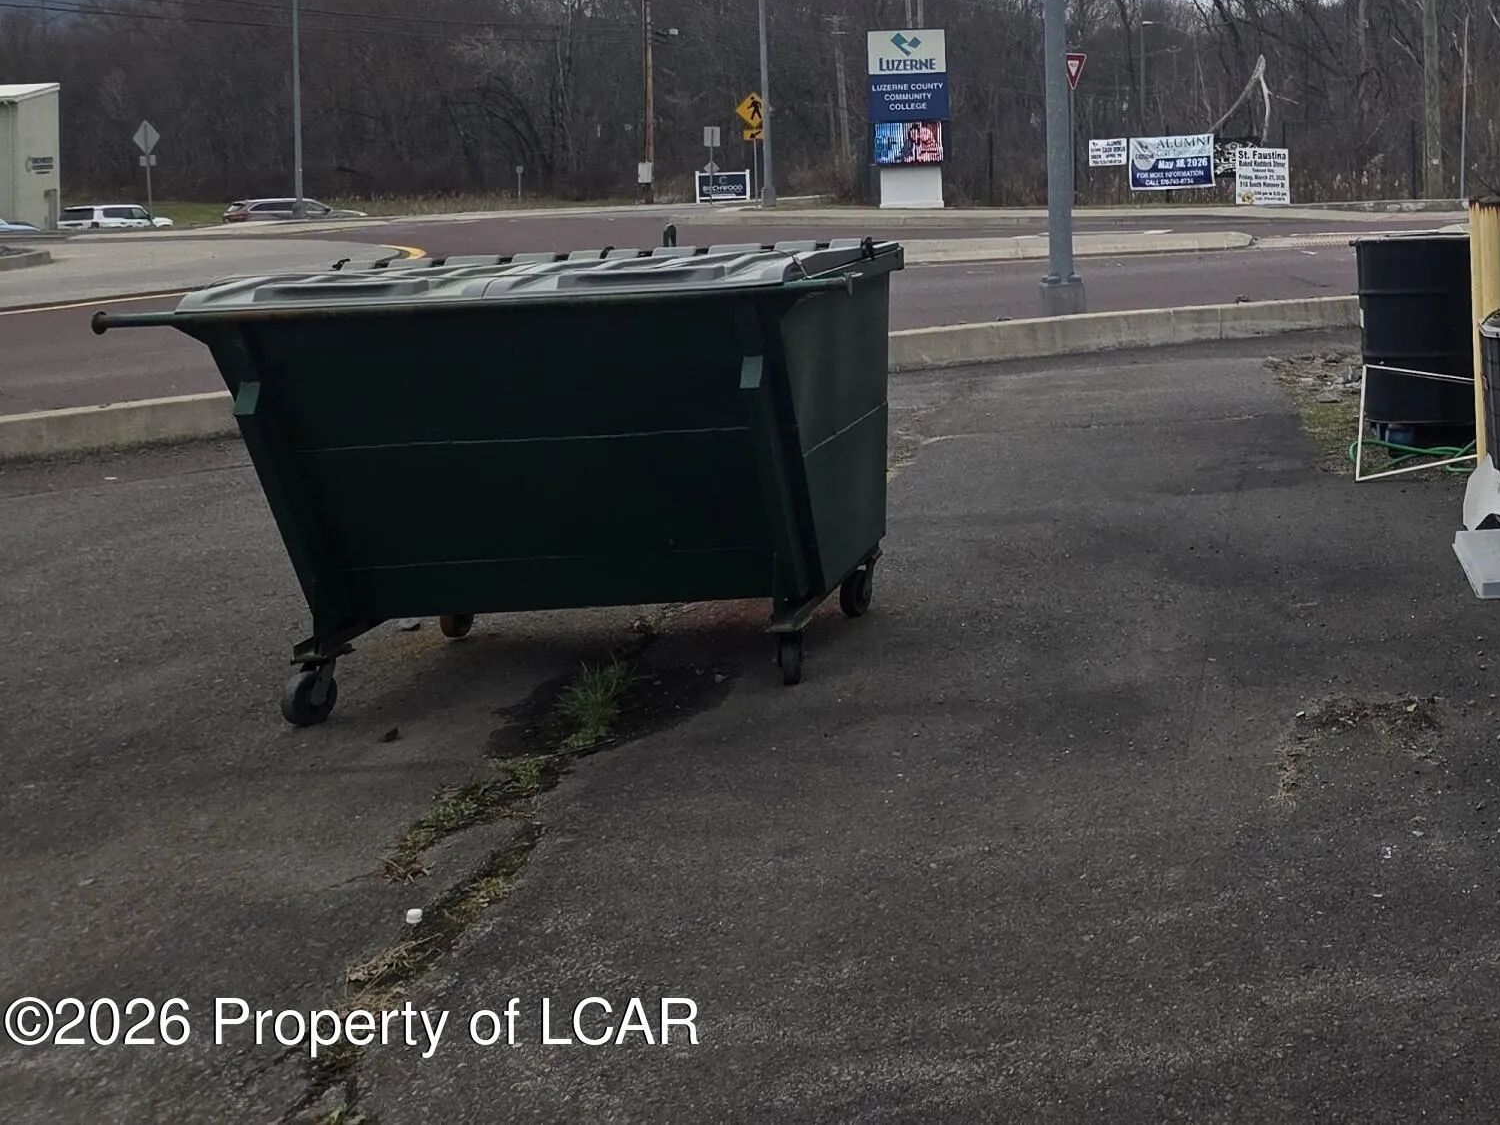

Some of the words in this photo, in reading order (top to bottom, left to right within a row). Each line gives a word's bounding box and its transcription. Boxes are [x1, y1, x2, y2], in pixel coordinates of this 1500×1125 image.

[879, 57, 937, 72] LUZERNE
[872, 84, 909, 92] LUZERNE
[910, 82, 944, 90] COUNTY
[884, 92, 932, 101] COMMUNITY
[889, 102, 928, 111] COLLEGE
[1156, 135, 1210, 149] ALUMNI
[1238, 150, 1250, 160] St.
[1252, 150, 1287, 161] Faustina
[1157, 159, 1175, 170] May
[1186, 157, 1208, 167] 2026
[1149, 171, 1164, 179] MORE
[1164, 170, 1205, 179] INFORMATION
[1144, 178, 1160, 186] CALL
